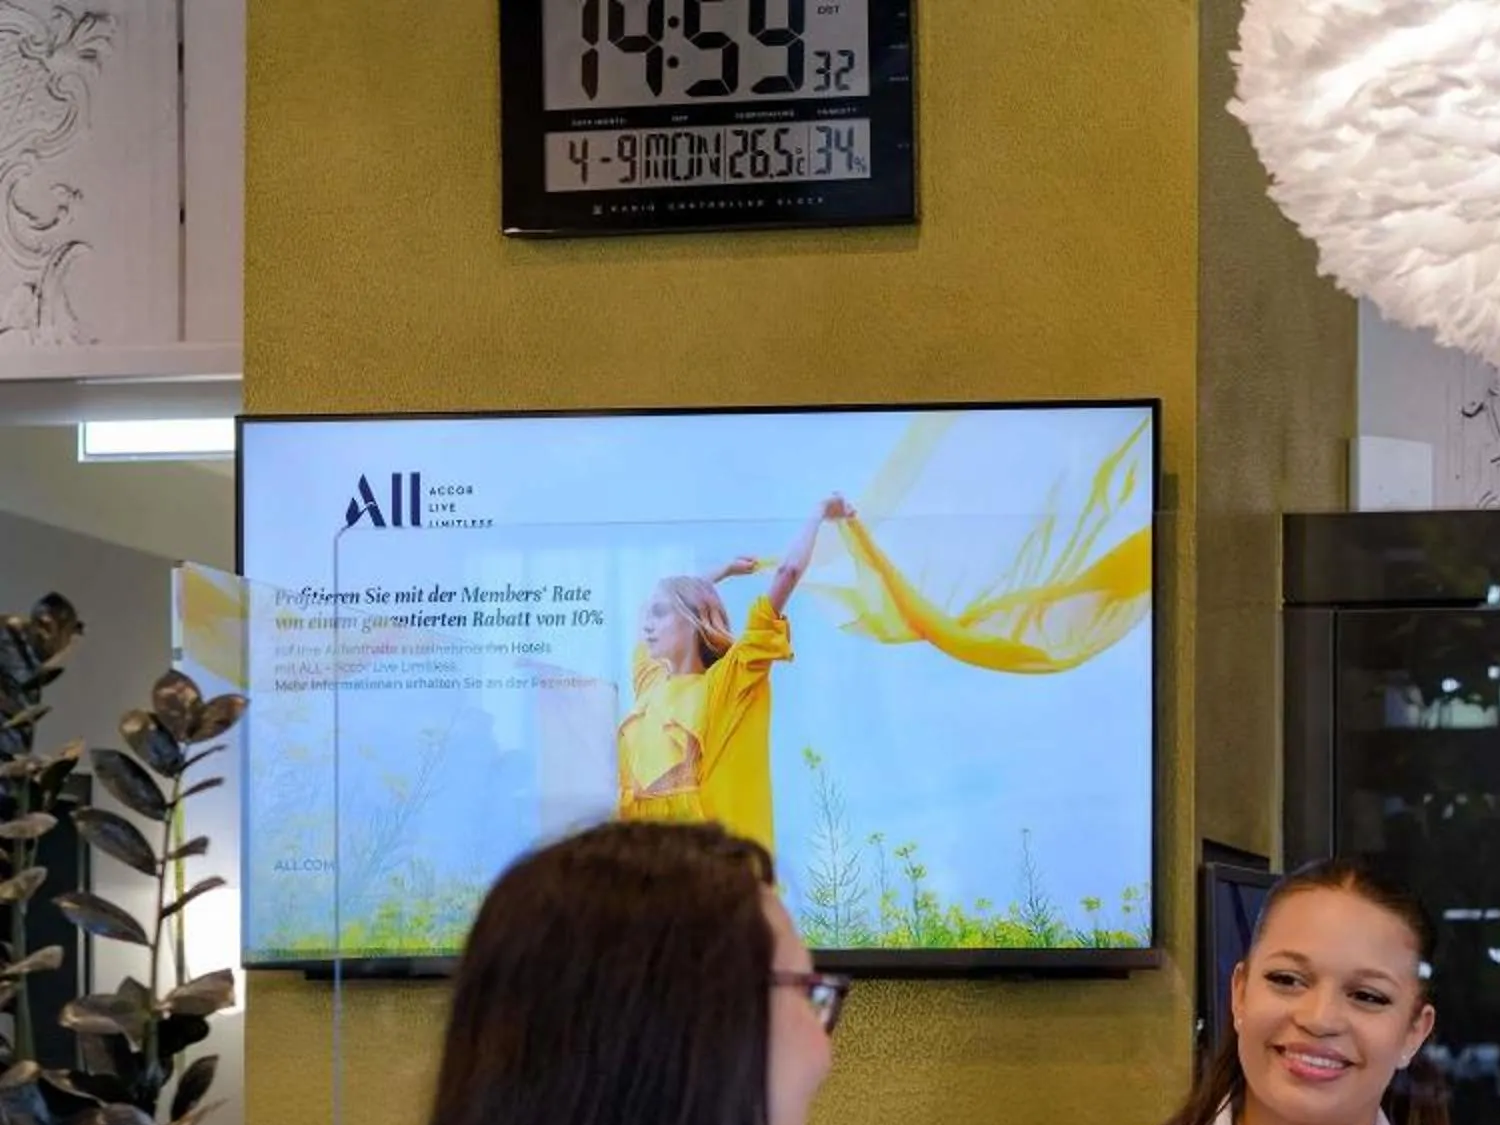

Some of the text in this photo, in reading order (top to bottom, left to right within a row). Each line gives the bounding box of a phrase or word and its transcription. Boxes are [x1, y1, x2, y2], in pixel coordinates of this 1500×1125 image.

[813, 50, 854, 91] 32
[645, 131, 721, 181] MON
[429, 485, 474, 496] ACCOR
[429, 502, 456, 512] LIVE
[429, 519, 494, 529] LIMITLESS
[275, 585, 360, 609] Profitieren
[365, 585, 391, 605] Sie
[394, 584, 424, 605] mit
[428, 583, 457, 603] der
[552, 584, 592, 603] Rate
[472, 607, 531, 628] Rabatt
[536, 614, 566, 627] von
[571, 609, 605, 627] 10%
[511, 641, 553, 654] Hotels
